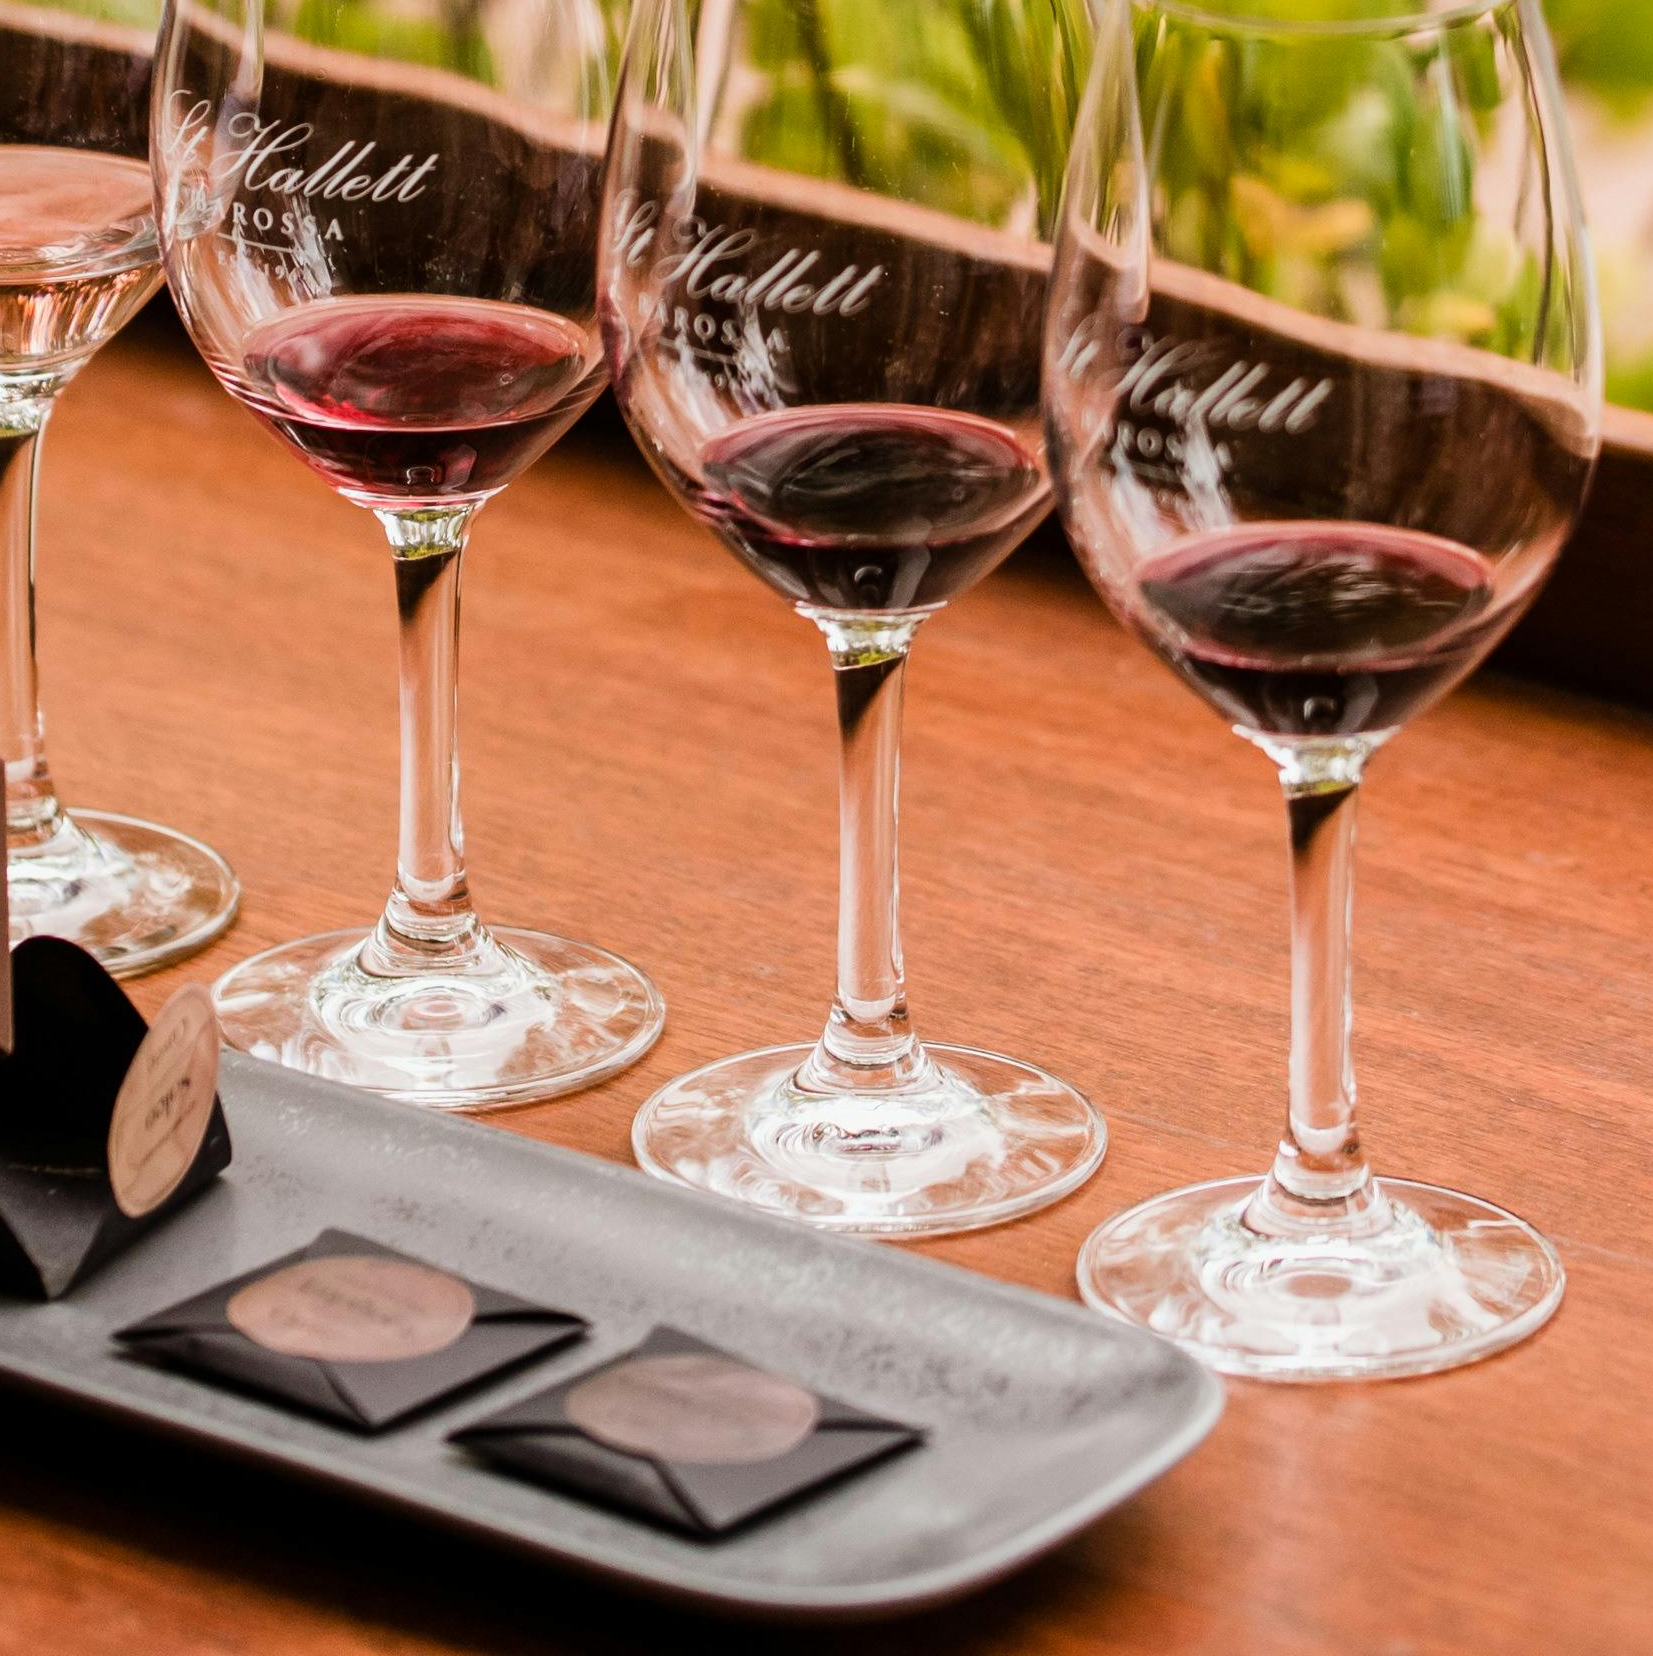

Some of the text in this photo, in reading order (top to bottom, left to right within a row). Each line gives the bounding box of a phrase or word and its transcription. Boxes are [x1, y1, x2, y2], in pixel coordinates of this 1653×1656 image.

[210, 111, 440, 204] Hallett
[650, 214, 888, 318] Hallett
[1108, 322, 1336, 435] Hallett
